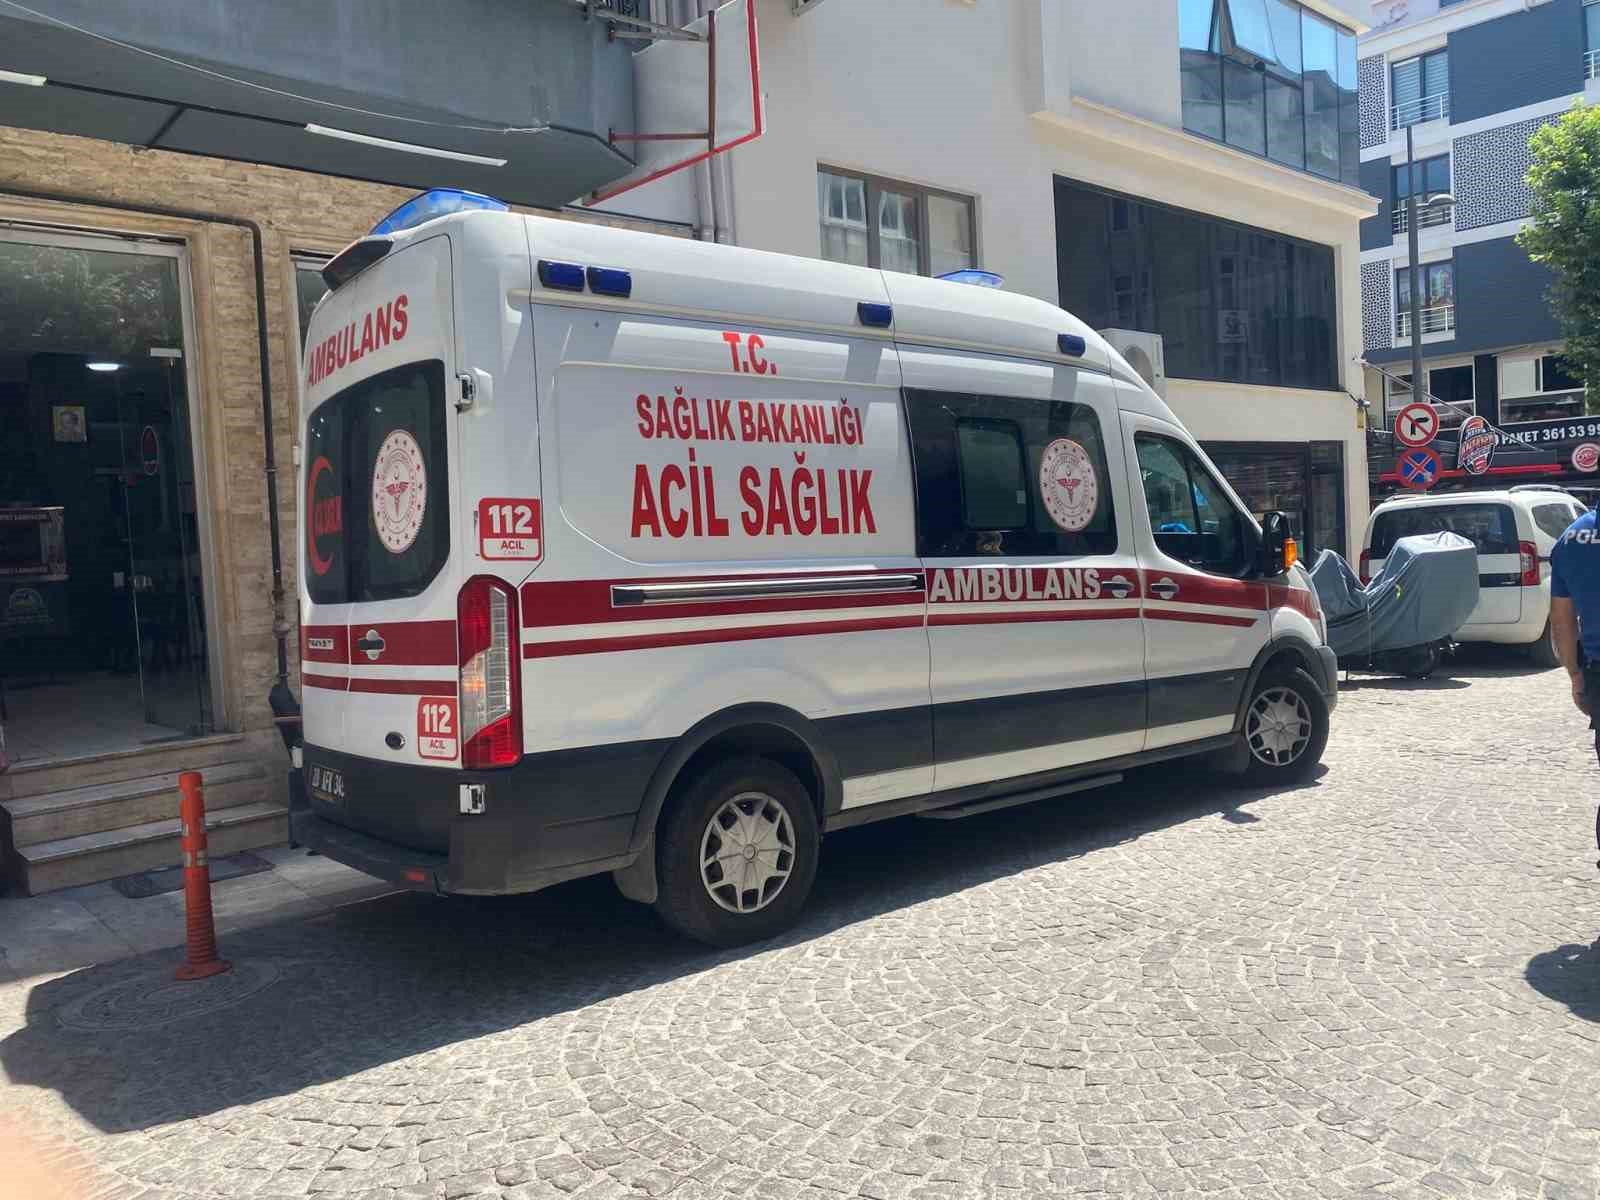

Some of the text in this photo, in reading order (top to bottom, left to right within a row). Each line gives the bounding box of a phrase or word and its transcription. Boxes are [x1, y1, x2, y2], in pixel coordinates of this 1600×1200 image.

[308, 294, 408, 386] AMBULANS
[722, 332, 777, 376] T.C.
[636, 386, 864, 445] SAĞLIK BAKANLIĞI
[1501, 430, 1540, 446] PAKET
[1543, 427, 1566, 441] 361
[1569, 424, 1586, 438] 33
[631, 447, 877, 539] ACİL SAĞLIK
[488, 504, 533, 534] 112
[930, 568, 1101, 602] AMBULANS
[422, 703, 452, 733] 112
